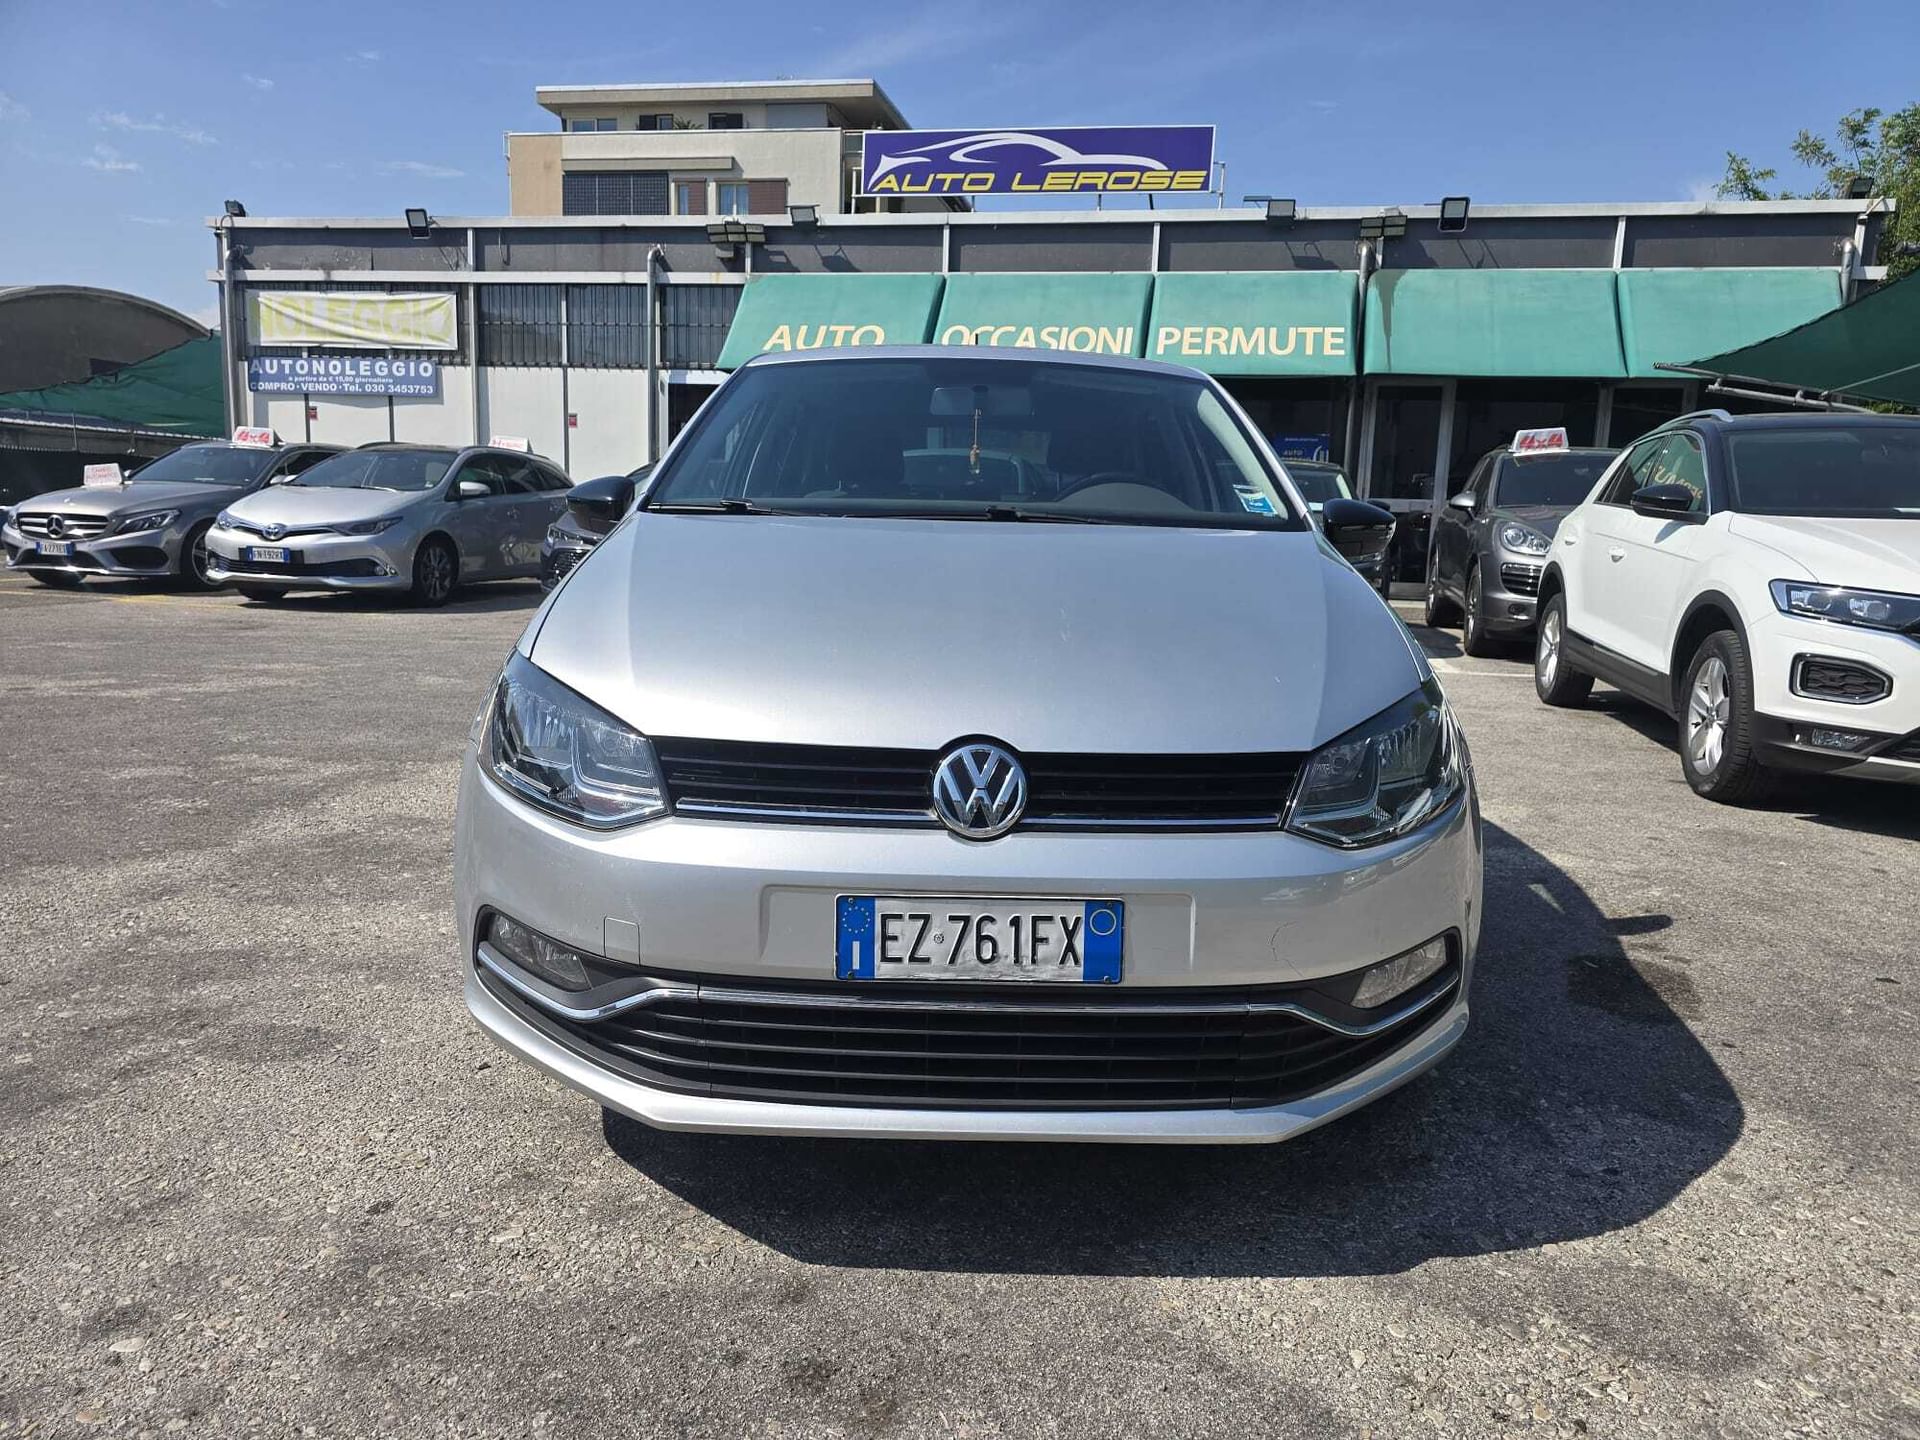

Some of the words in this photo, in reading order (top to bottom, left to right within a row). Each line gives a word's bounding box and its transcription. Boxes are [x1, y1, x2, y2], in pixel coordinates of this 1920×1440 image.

[871, 173, 996, 192] AUTO
[1010, 170, 1207, 192] LEROSE
[762, 325, 886, 351] AUTO
[941, 325, 1134, 355] OCCASIONI
[1156, 326, 1346, 356] PERMUTE
[250, 358, 434, 378] AUTONOLEGGIO
[301, 383, 337, 392] VENDO
[365, 385, 385, 393] 030
[879, 913, 931, 963] EZ
[948, 915, 1081, 966] 761FX
